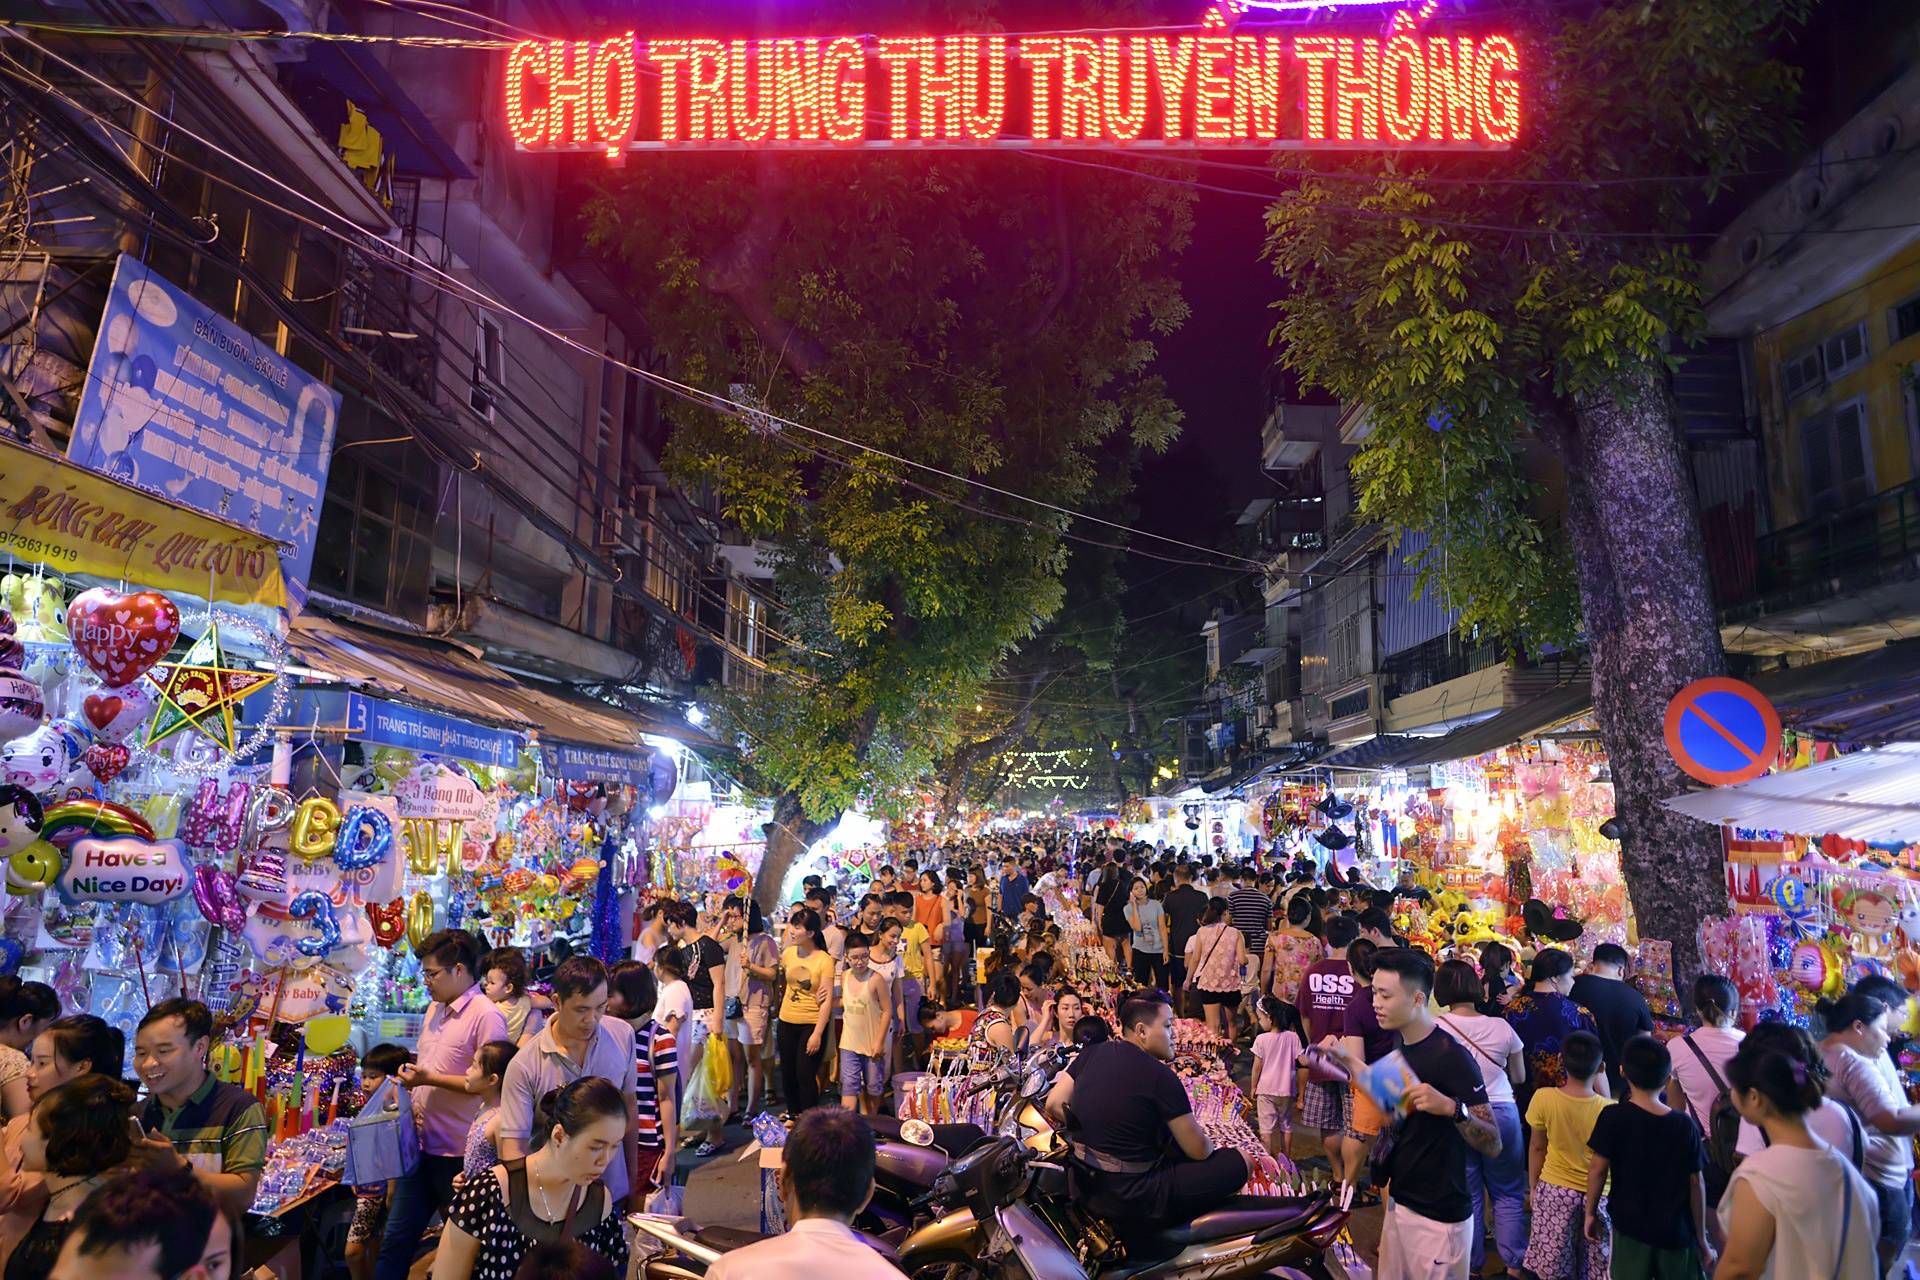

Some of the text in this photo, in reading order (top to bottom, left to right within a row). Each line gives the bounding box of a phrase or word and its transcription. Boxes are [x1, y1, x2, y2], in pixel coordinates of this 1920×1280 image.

[505, 30, 637, 159] CHỢ
[648, 36, 867, 143] TRUNG
[879, 37, 1007, 141] THU
[1293, 0, 1521, 144] THỐNG
[219, 334, 249, 365] BUÔN
[91, 512, 157, 552] BAY
[72, 617, 141, 649] Happy
[357, 703, 367, 730] 3
[377, 714, 407, 735] TRANG
[408, 721, 422, 736] TRÍ
[422, 726, 441, 741] SINH
[462, 735, 479, 750] THEO
[86, 752, 114, 767] Day!
[507, 739, 514, 763] 3
[413, 784, 420, 799] 3
[423, 785, 453, 804] Hàng
[85, 850, 167, 867] Have a
[73, 873, 183, 895] Nice Day!
[293, 988, 321, 1001] Baby
[1309, 973, 1355, 995] OSS
[1315, 994, 1344, 1005] Health
